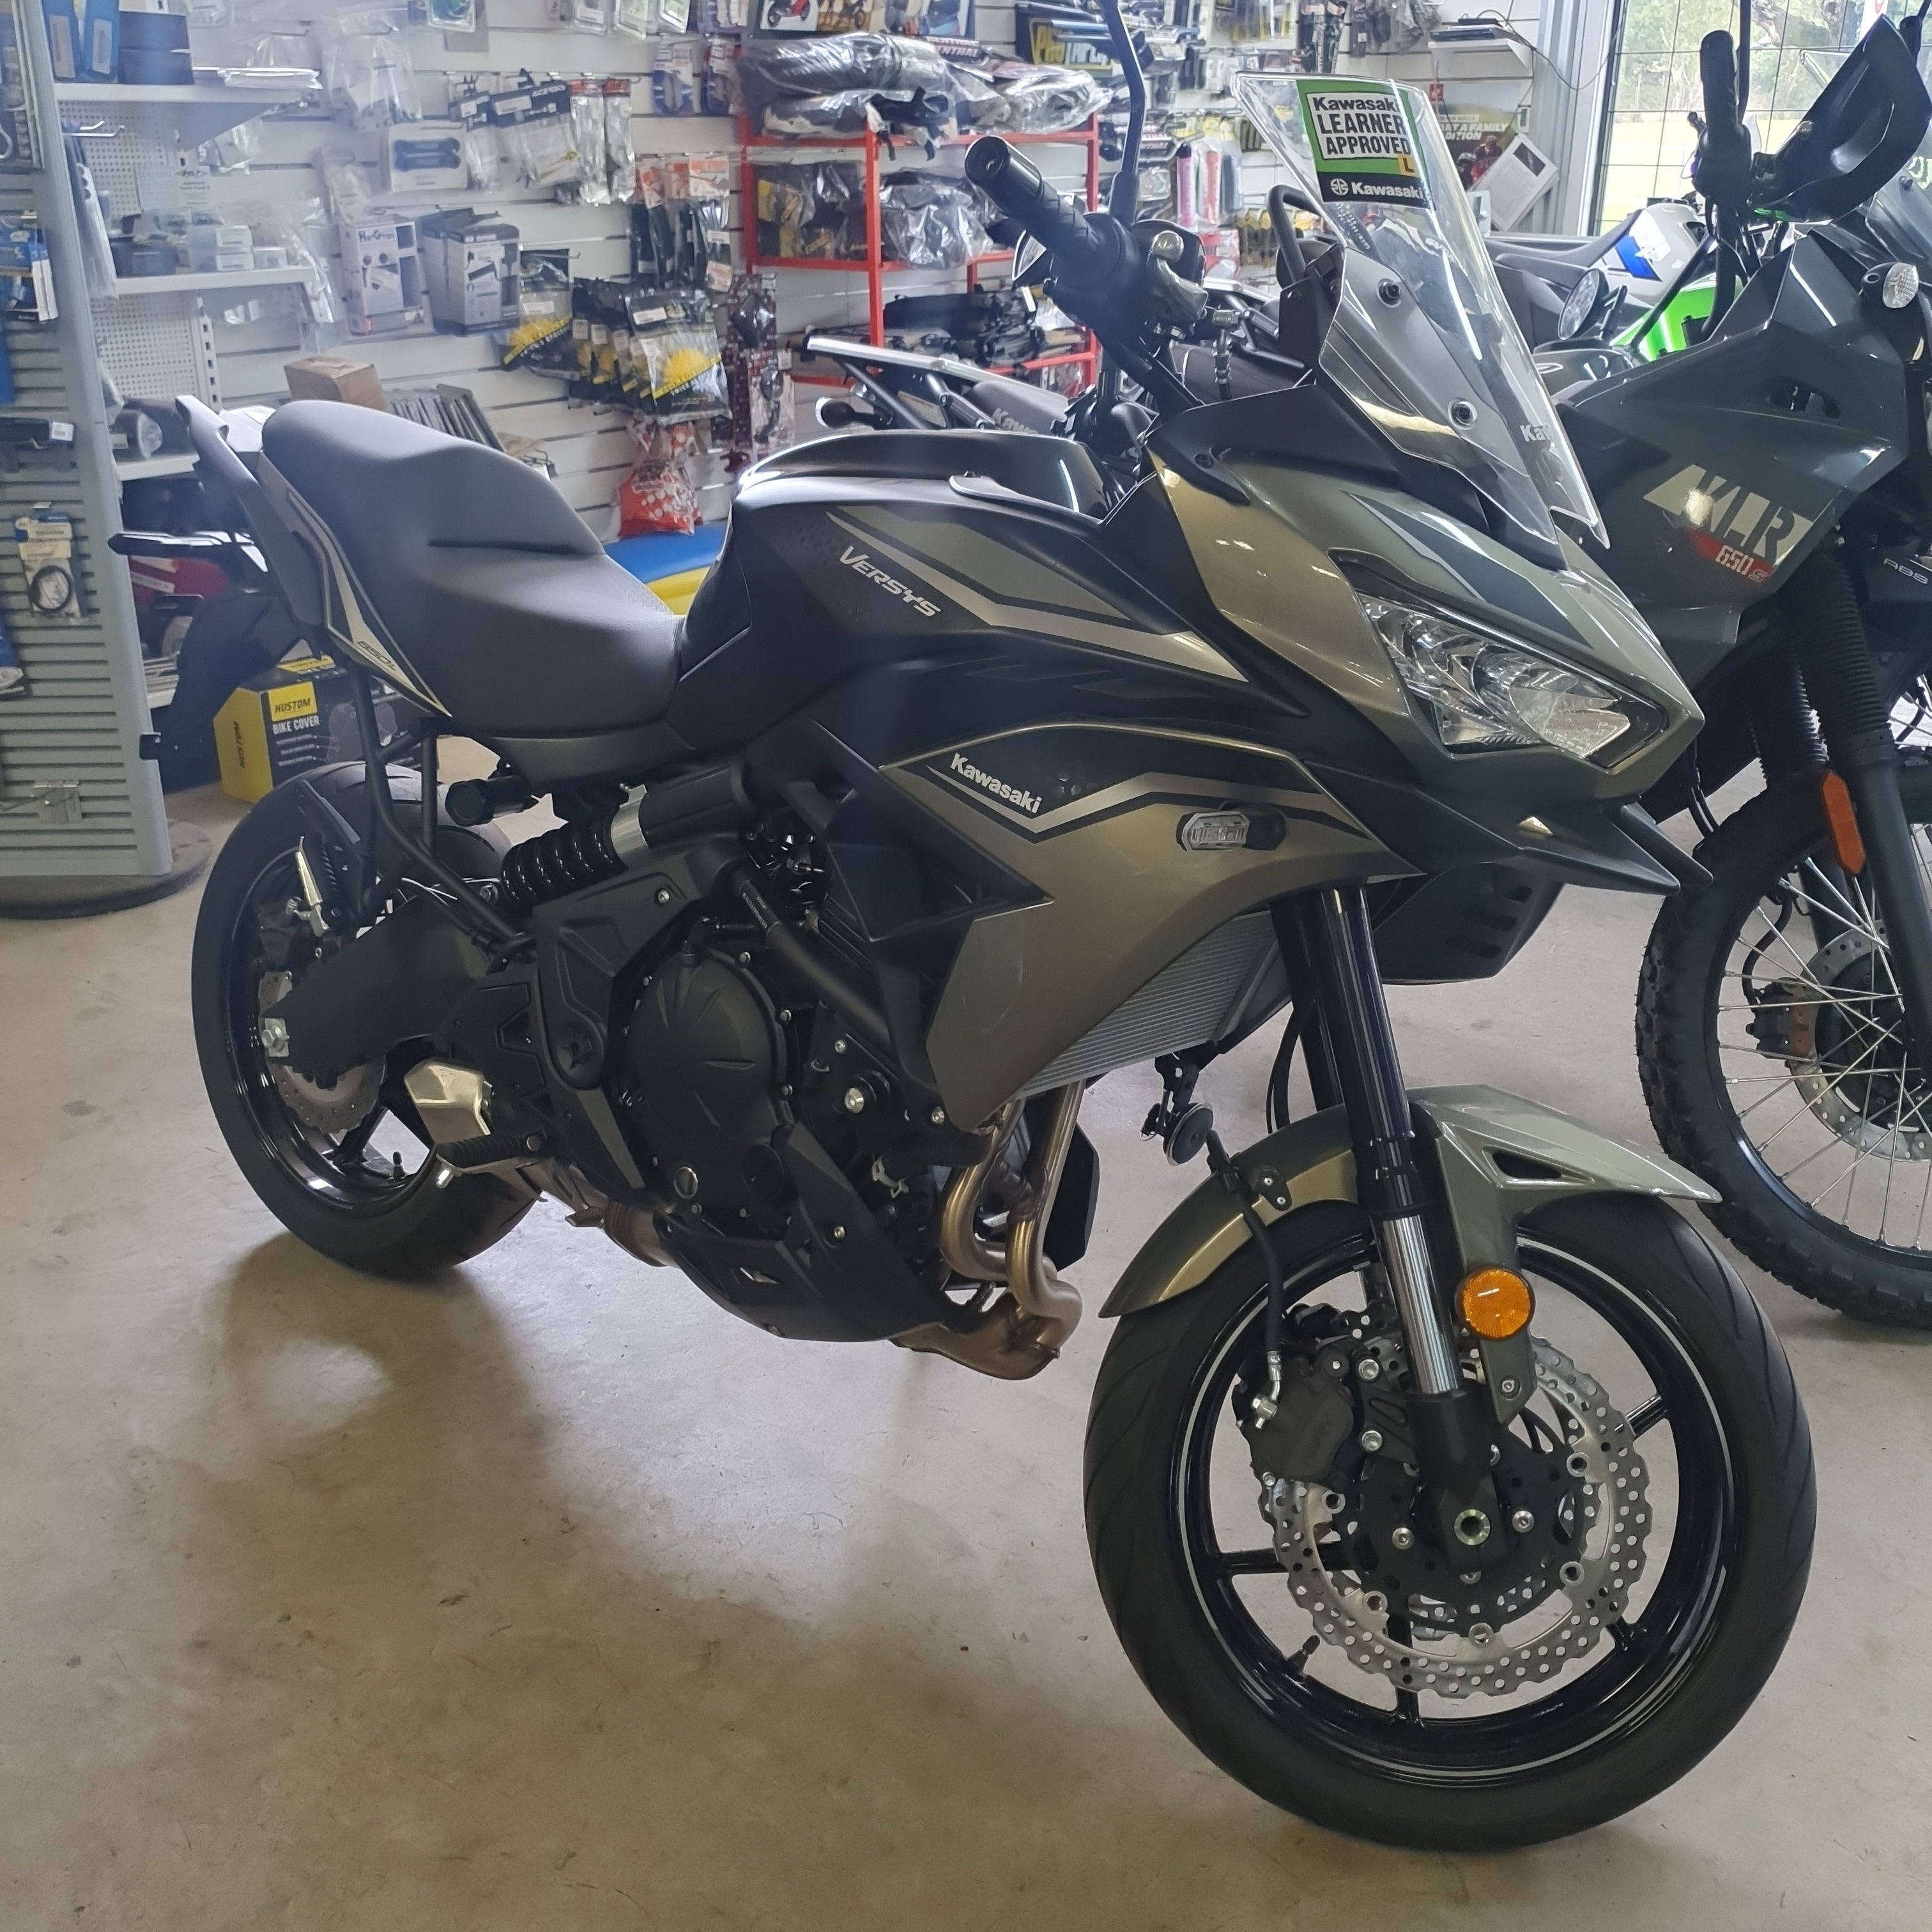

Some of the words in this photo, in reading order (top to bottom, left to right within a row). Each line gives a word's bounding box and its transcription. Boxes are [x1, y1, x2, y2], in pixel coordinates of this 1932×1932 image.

[1312, 96, 1401, 112] Kawasaki
[1317, 113, 1407, 135] LEARNER
[1469, 122, 1509, 132] FAMILY
[1327, 135, 1412, 156] APPROVED
[1402, 158, 1414, 173] L
[1351, 181, 1423, 199] Kawasaki
[1671, 466, 1800, 565] KLR
[1715, 544, 1755, 576] 650
[839, 546, 942, 618] VERSYS
[1883, 558, 1929, 585] ABS
[272, 720, 293, 735] BIKE
[293, 715, 320, 730] COVER
[951, 753, 1043, 814] Kawasaki
